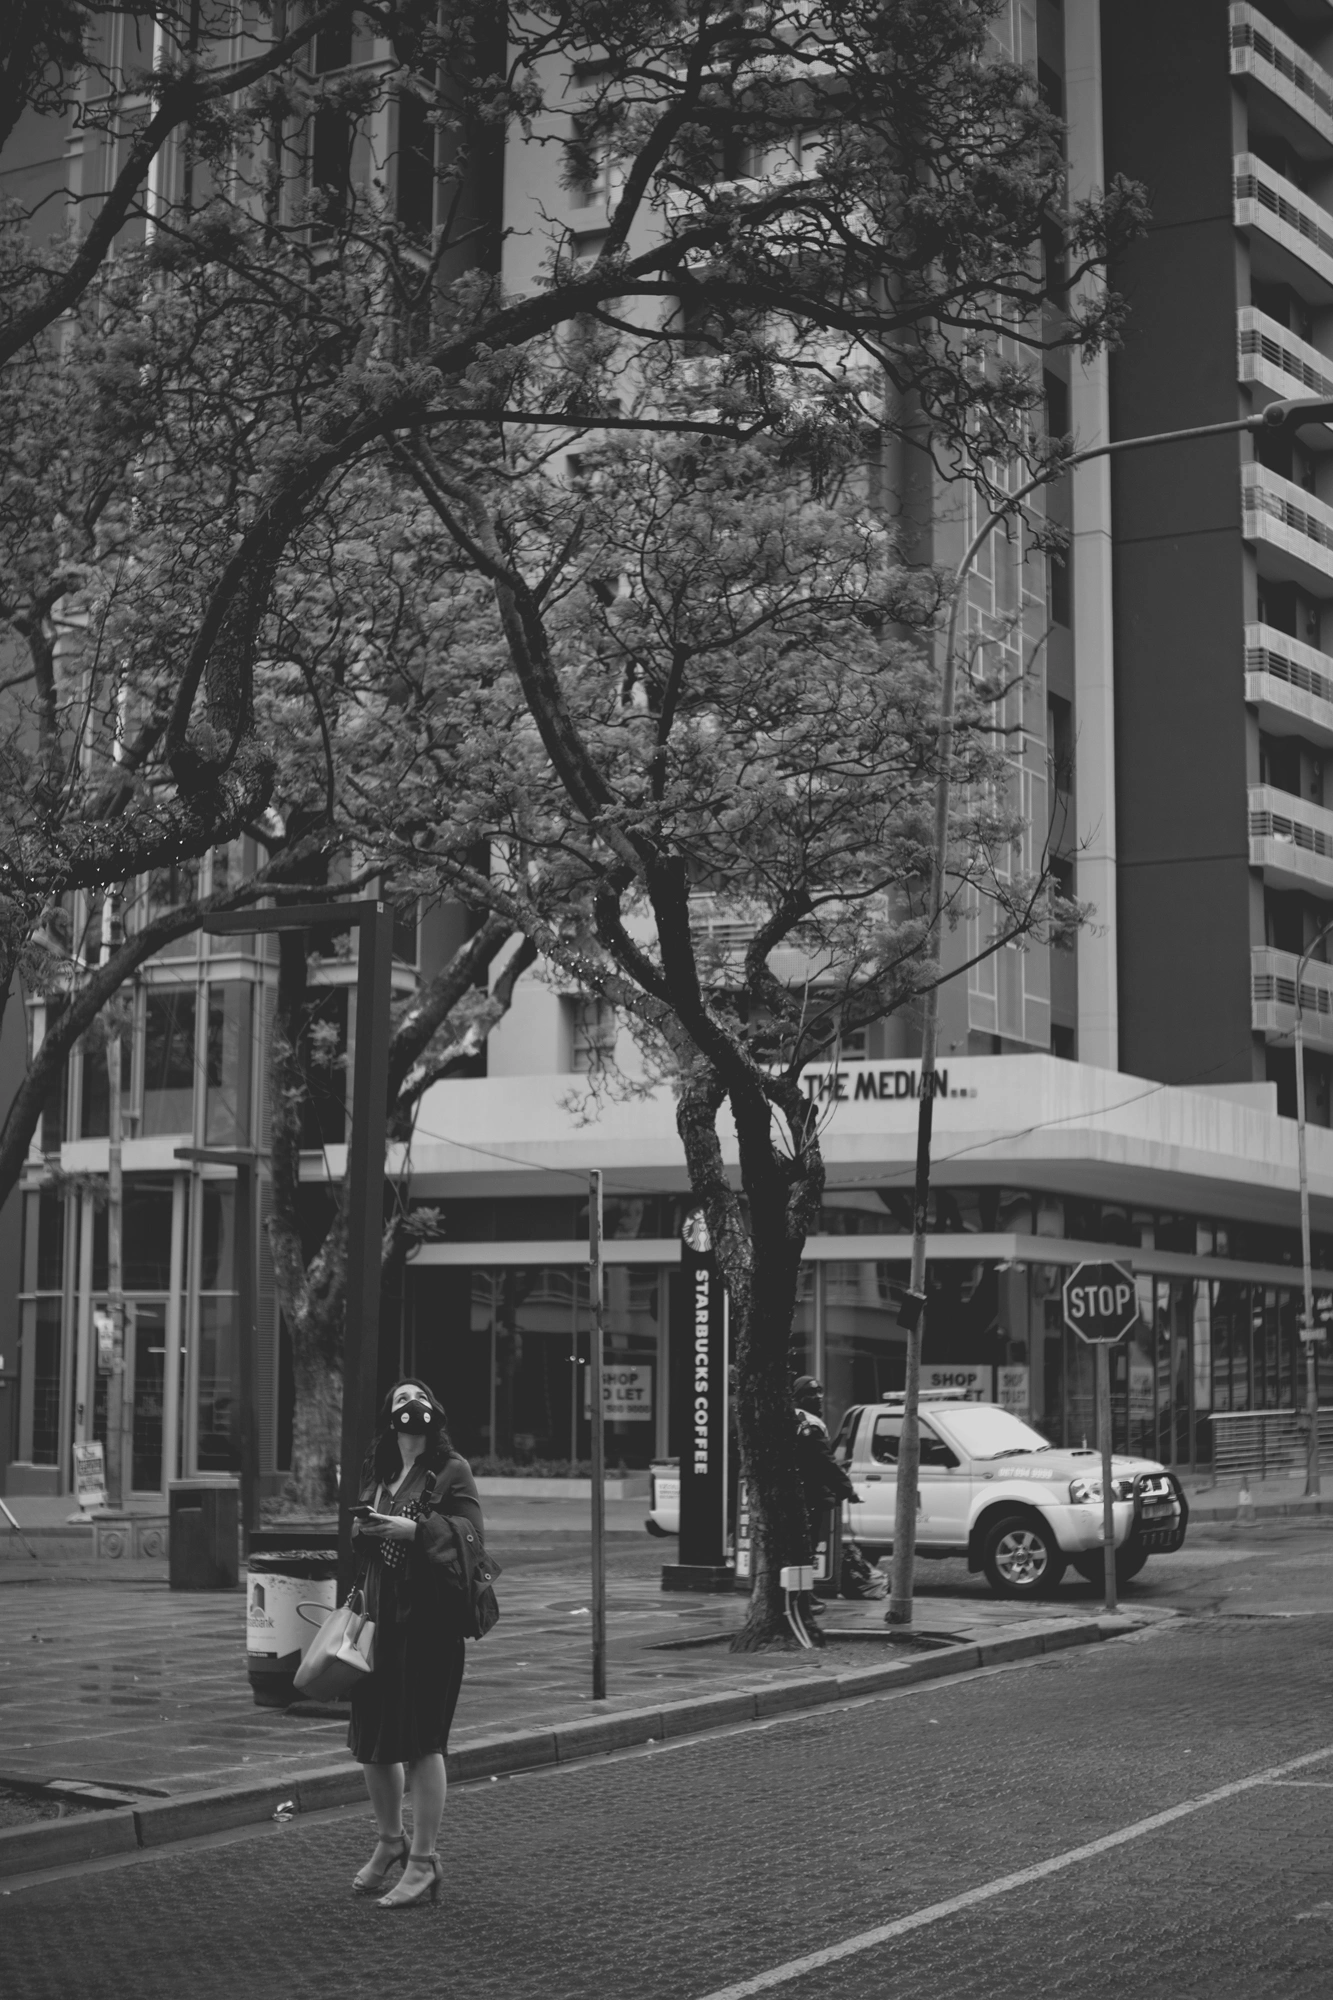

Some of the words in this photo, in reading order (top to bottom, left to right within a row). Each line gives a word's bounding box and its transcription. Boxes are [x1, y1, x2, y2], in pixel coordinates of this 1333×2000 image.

[803, 1072, 849, 1102] THE
[1070, 1284, 1131, 1319] STOP
[694, 1269, 710, 1393] STARBUCKS
[616, 1388, 644, 1401] LET
[931, 1373, 977, 1387] SHOP
[693, 1396, 709, 1475] COFFEE
